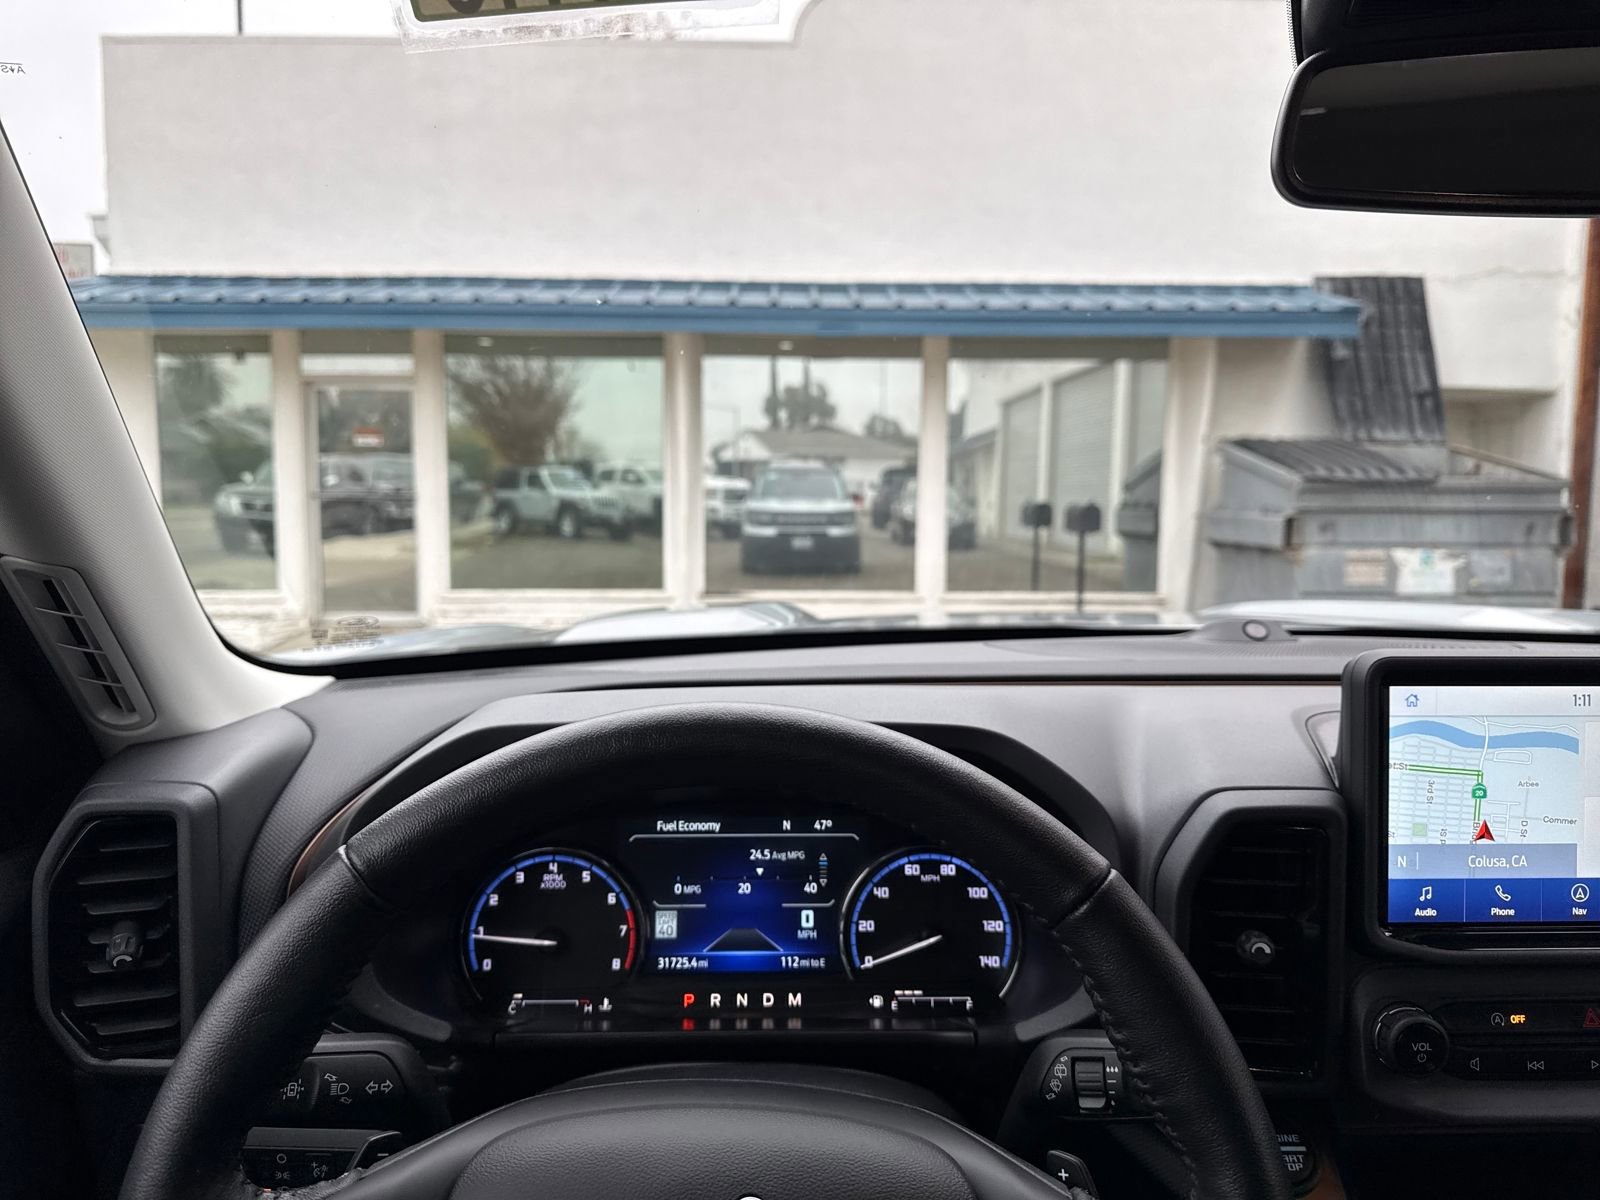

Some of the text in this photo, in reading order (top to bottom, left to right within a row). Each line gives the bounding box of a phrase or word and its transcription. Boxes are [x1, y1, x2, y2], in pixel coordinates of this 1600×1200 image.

[1572, 694, 1591, 707] 1:11
[1427, 780, 1435, 794] 3rd
[783, 820, 791, 830] N
[1543, 816, 1577, 825] Commer
[657, 821, 721, 832] Fuel Economy
[750, 850, 805, 861] 24.5 Avg MPG
[549, 862, 558, 872] 4
[1397, 856, 1407, 867] N
[1468, 855, 1527, 868] Colusa, CA
[904, 864, 920, 875] 60
[940, 864, 956, 875] 80
[515, 872, 524, 883] 3
[543, 873, 563, 881] RPM
[582, 871, 591, 882] 5
[920, 874, 940, 882] MPH
[674, 884, 702, 894] 0 MPG
[738, 883, 751, 894] 20
[804, 883, 818, 894] 40
[873, 887, 889, 898] 40
[967, 887, 988, 898] 100
[489, 894, 498, 905] 2
[607, 893, 616, 905] 6
[1415, 908, 1437, 916] Audio
[1491, 908, 1515, 916] Phone
[1572, 907, 1587, 915] Nav
[801, 910, 814, 927] 0
[619, 925, 628, 936] 7
[658, 925, 674, 936] 40
[858, 920, 875, 931] 20
[982, 920, 1003, 931] 120
[797, 930, 817, 939] MPH
[483, 959, 491, 970] 0
[611, 958, 621, 970] 8
[657, 958, 708, 969] 31725.4 mi
[780, 956, 798, 967] 112
[820, 958, 826, 967] E
[864, 956, 873, 967] 0
[979, 956, 1000, 967] 140
[683, 993, 802, 1007] P R N D M
[891, 1001, 898, 1010] E
[966, 1000, 973, 1010] F
[584, 1004, 592, 1013] H
[1510, 1015, 1526, 1023] OFF
[1411, 1042, 1432, 1051] VOL
